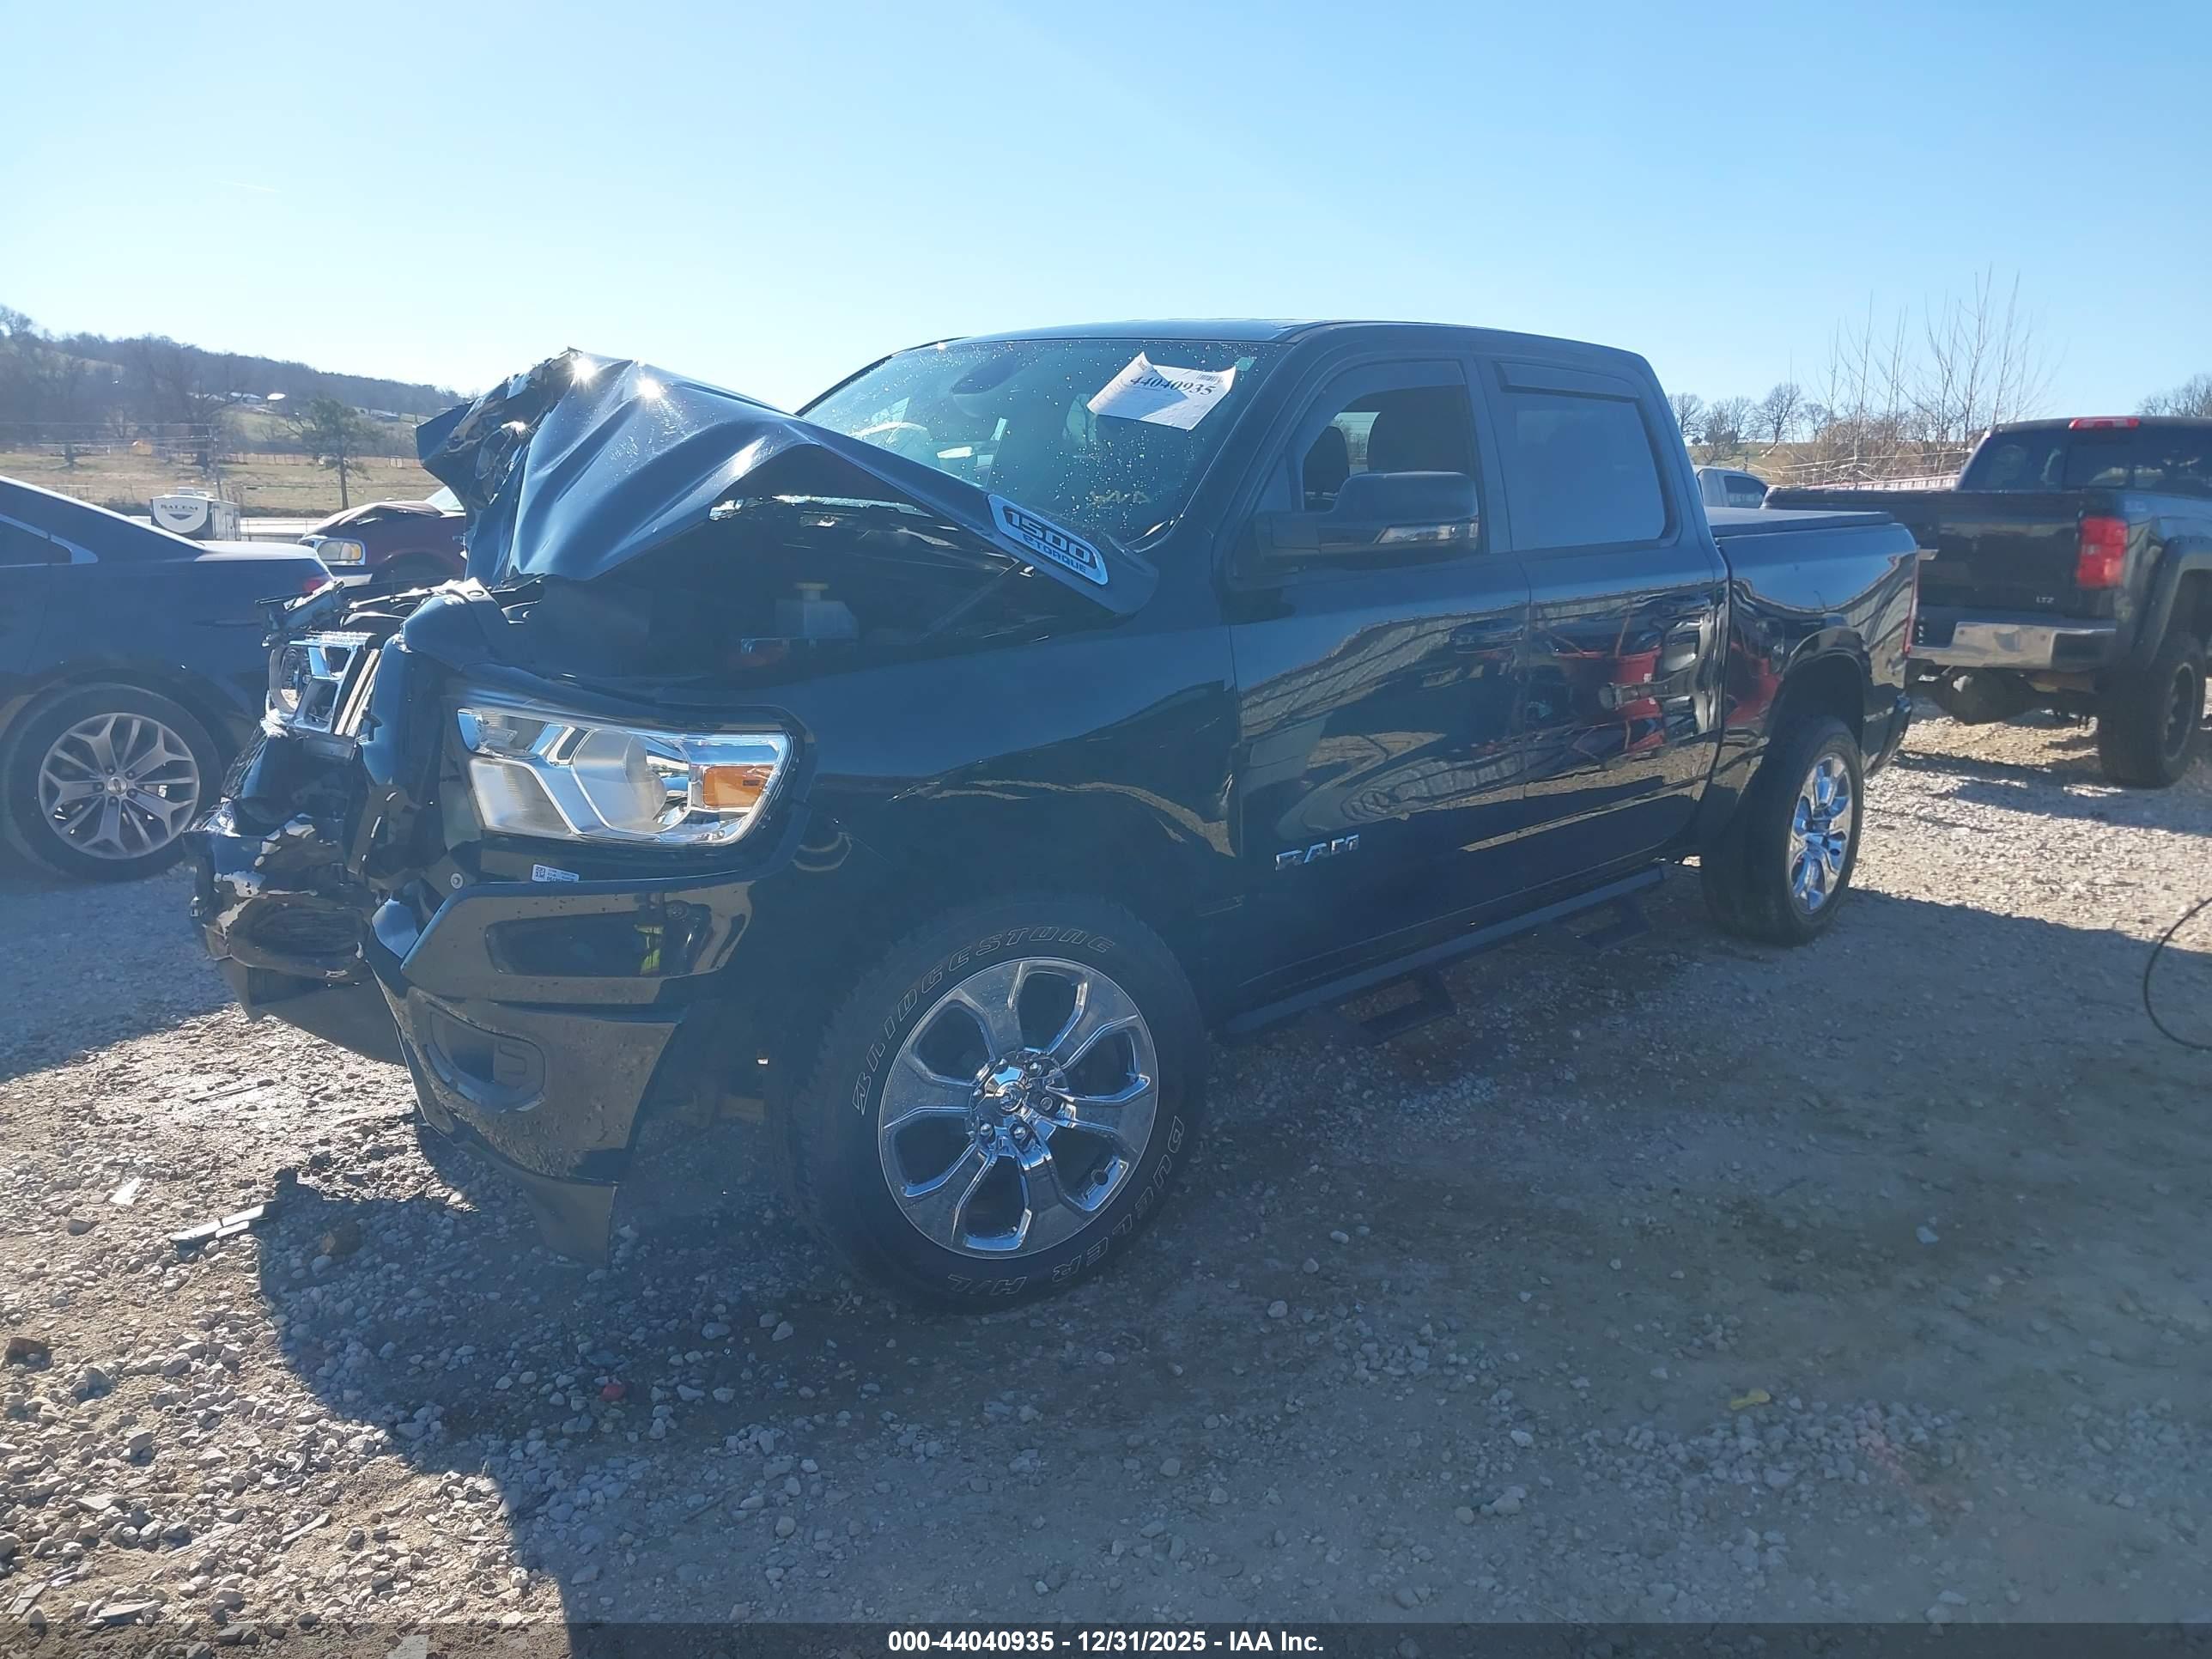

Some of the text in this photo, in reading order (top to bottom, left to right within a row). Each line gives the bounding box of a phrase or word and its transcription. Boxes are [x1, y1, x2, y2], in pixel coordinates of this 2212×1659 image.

[1130, 375, 1217, 396] 44040935
[1006, 509, 1091, 563] 1500
[1275, 834, 1359, 872] RAM
[852, 925, 1115, 1116] BRIDGESTONE
